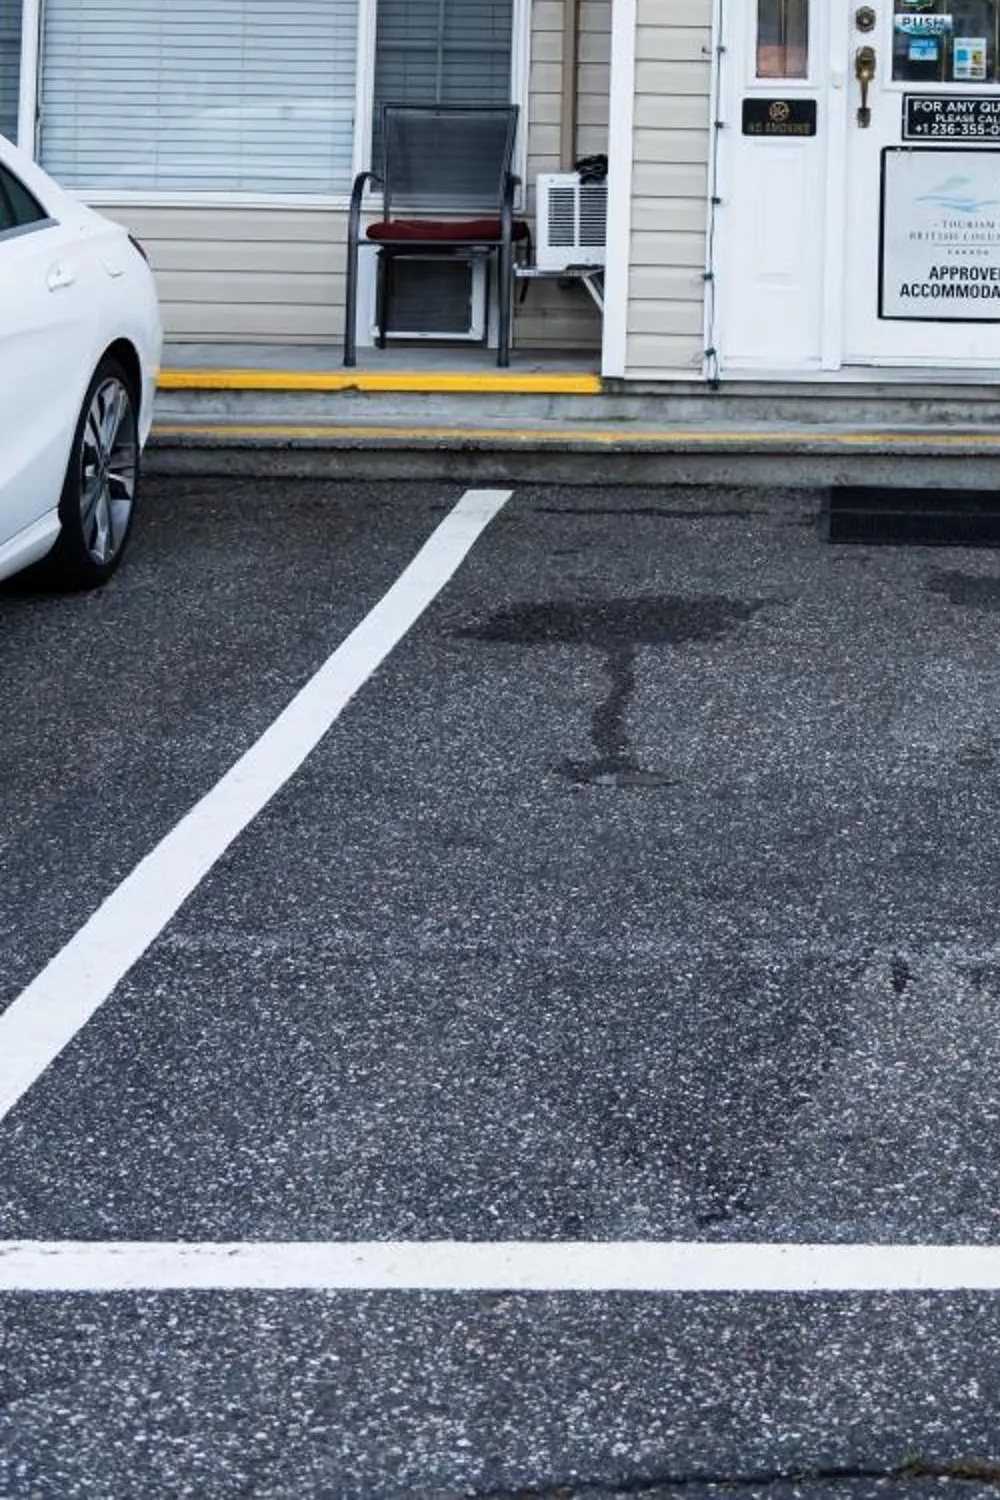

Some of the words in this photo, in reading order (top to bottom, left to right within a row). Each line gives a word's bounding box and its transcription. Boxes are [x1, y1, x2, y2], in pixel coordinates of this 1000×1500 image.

[901, 16, 945, 28] PUSH
[913, 101, 942, 113] FOR
[945, 102, 976, 113] ANY
[935, 113, 975, 123] PLEASE
